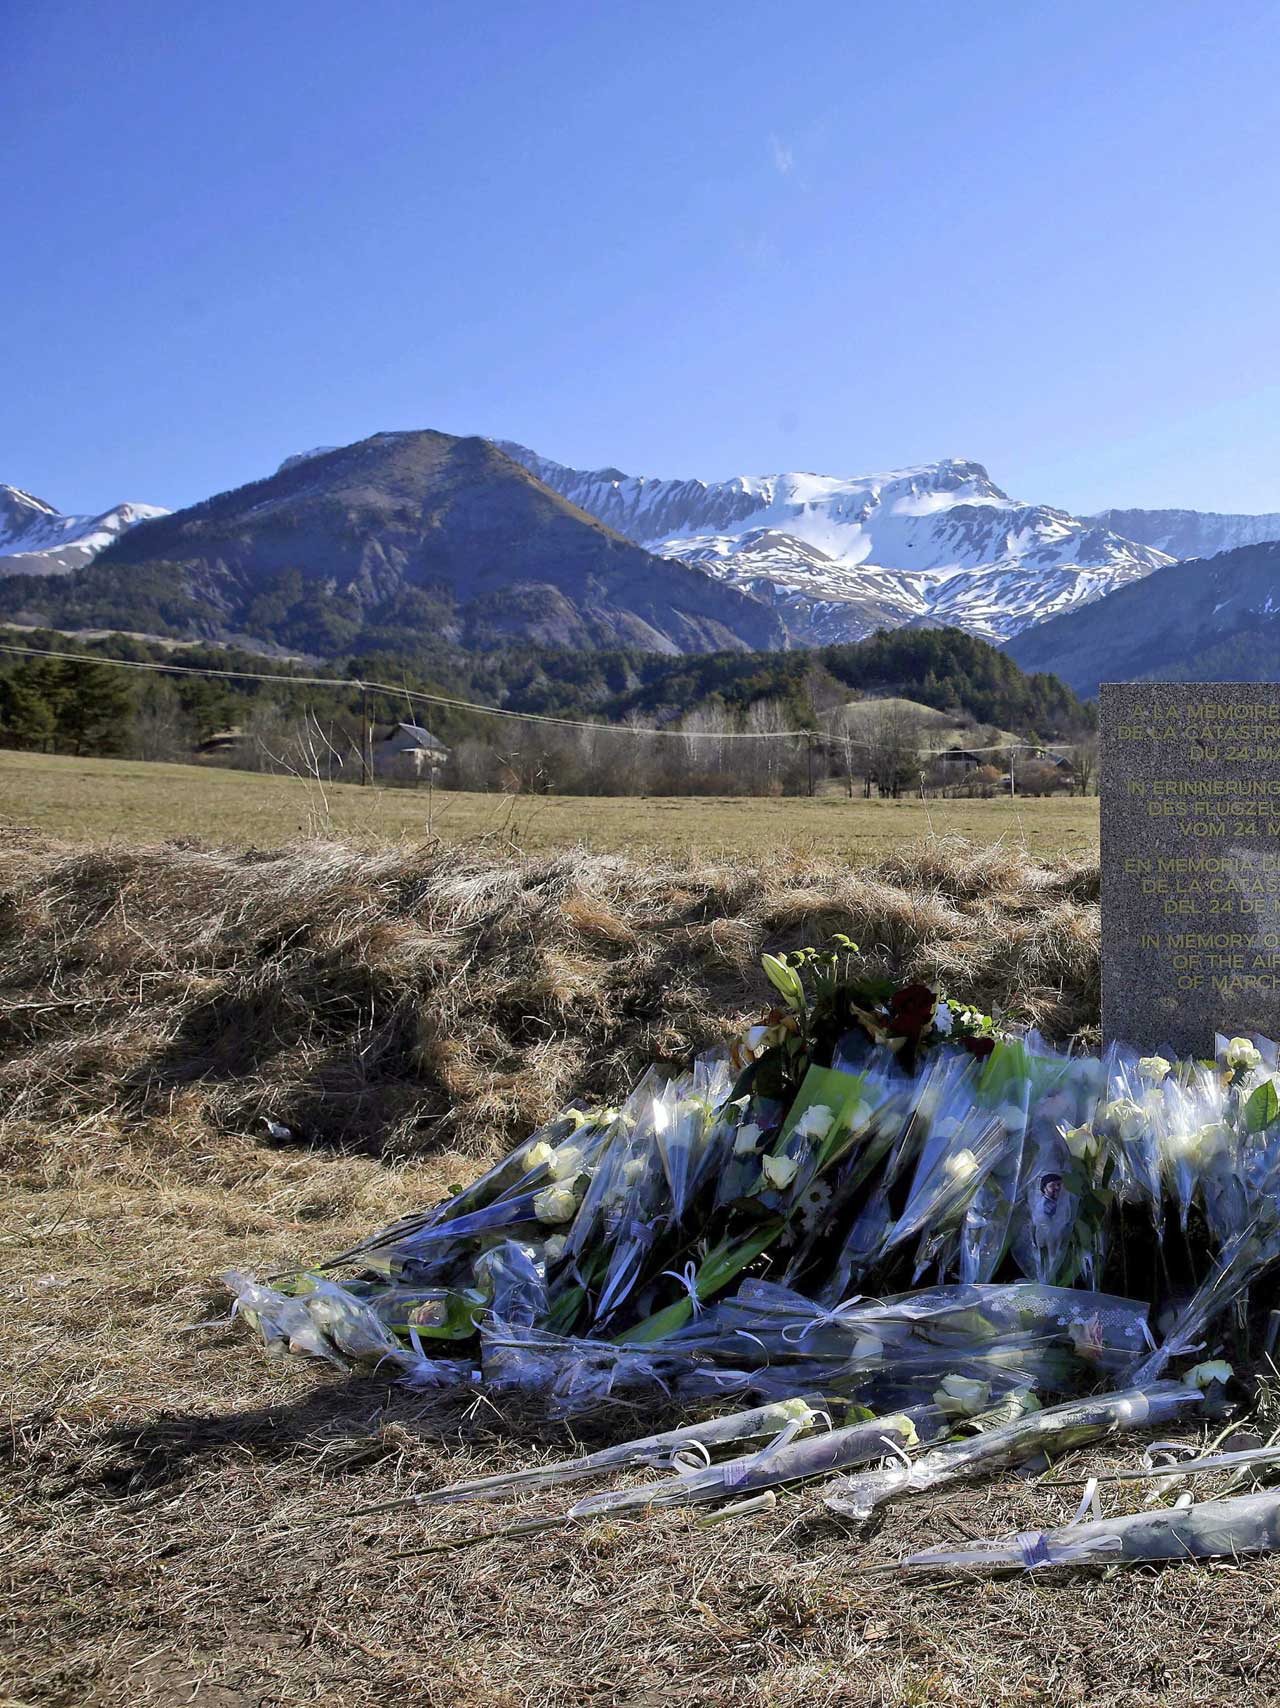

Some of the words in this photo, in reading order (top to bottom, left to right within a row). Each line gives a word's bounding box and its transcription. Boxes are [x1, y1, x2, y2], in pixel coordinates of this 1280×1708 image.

[1153, 704, 1179, 719] LA
[1118, 726, 1143, 740] DE
[1151, 726, 1175, 740] LA
[1190, 747, 1217, 761] DU
[1226, 746, 1249, 760] 24
[1128, 781, 1144, 796] IN
[1153, 781, 1280, 795] ERINNERUNG
[1148, 802, 1187, 816] DES
[1180, 822, 1225, 836] VOM
[1124, 858, 1150, 872] EN
[1158, 858, 1252, 872] MEMORIA
[1142, 879, 1168, 893] DE
[1176, 878, 1200, 893] LA
[1164, 900, 1200, 914] DEL
[1209, 900, 1232, 913] 24
[1240, 899, 1266, 913] DE
[1141, 934, 1160, 948] IN
[1168, 933, 1255, 948] MEMORY
[1173, 955, 1199, 969] OF
[1206, 954, 1244, 968] THE
[1178, 975, 1204, 989] OF
